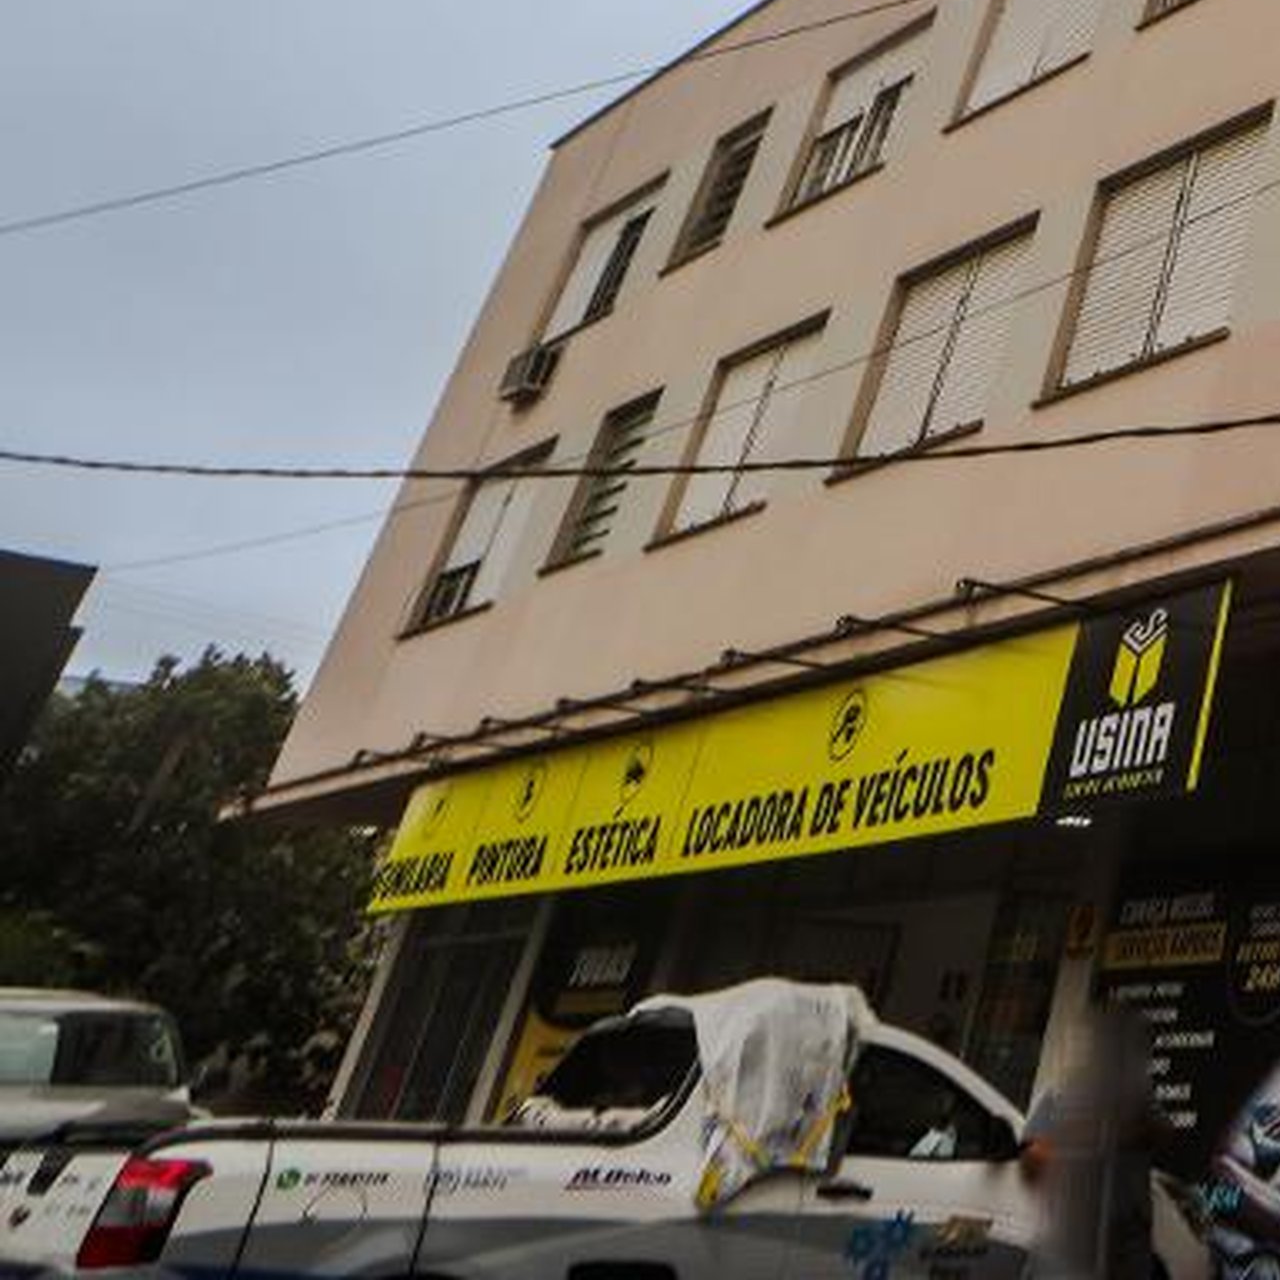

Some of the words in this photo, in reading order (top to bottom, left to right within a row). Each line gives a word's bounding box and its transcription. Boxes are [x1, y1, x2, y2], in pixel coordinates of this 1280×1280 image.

[1069, 701, 1176, 778] USINA
[681, 784, 810, 857] LOCADORA
[809, 778, 852, 837] DE
[852, 747, 995, 829] VEÍCULOS
[466, 835, 548, 887] PINTURA
[564, 807, 662, 875] ESTÉTICA
